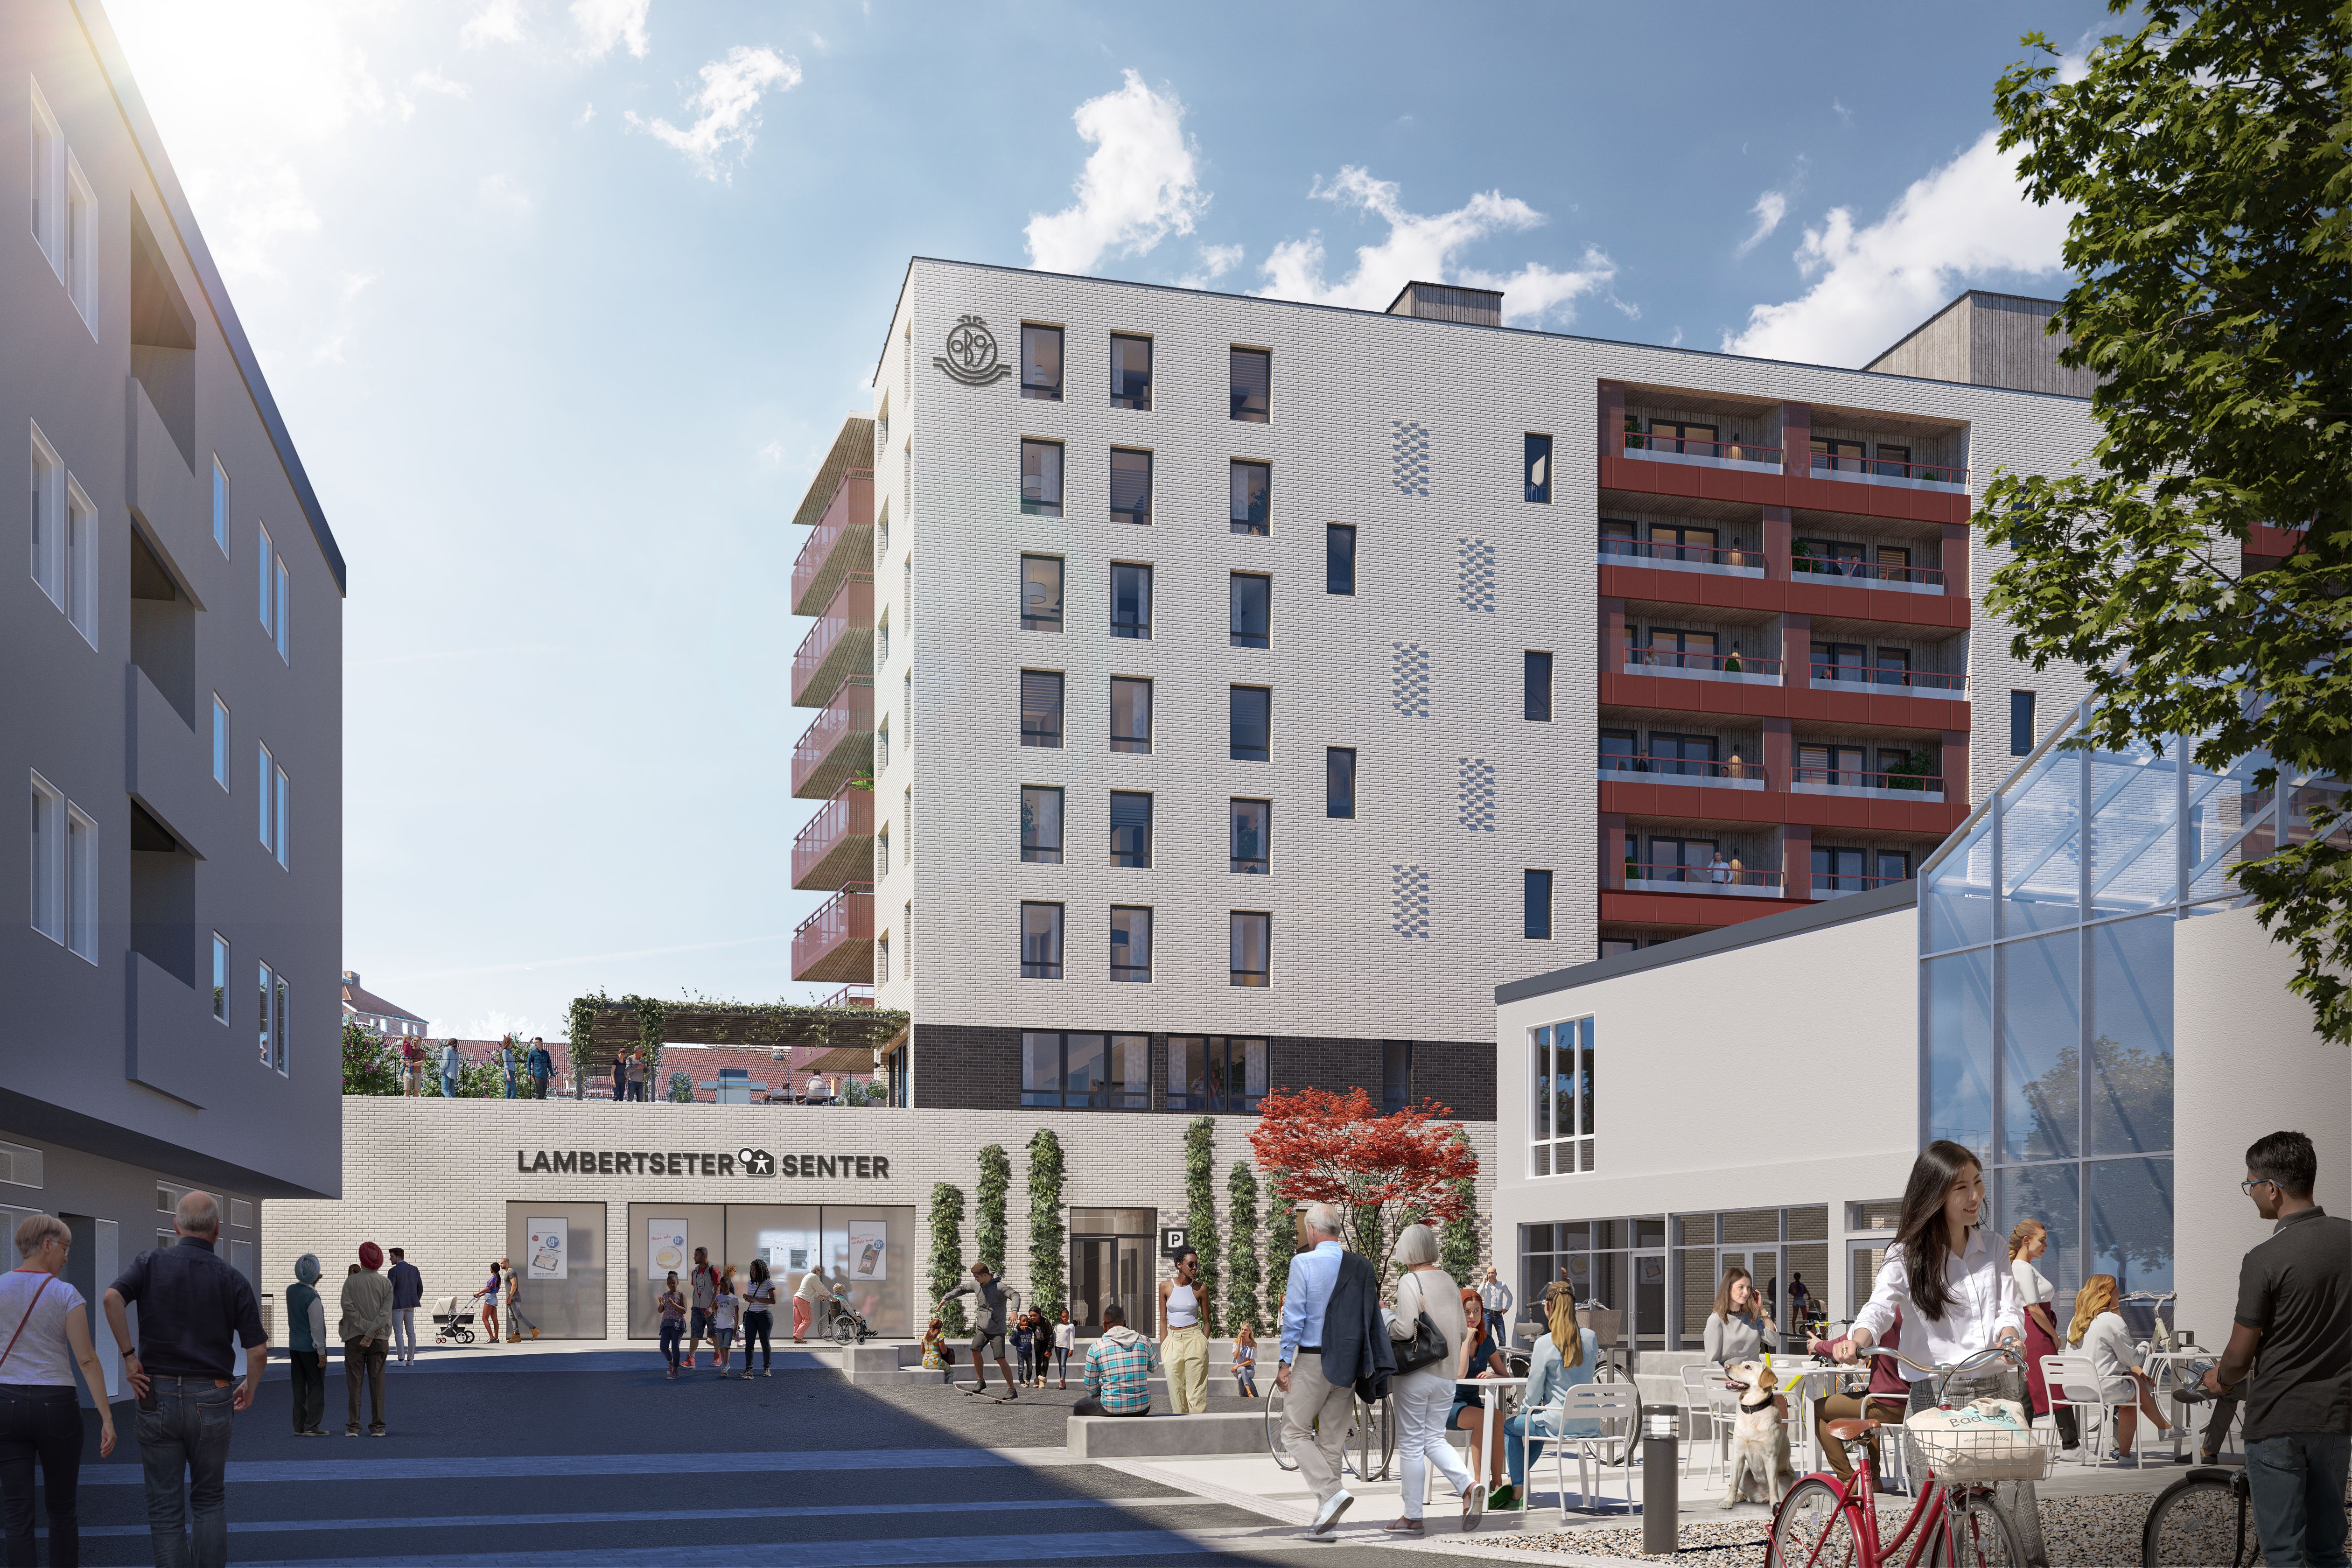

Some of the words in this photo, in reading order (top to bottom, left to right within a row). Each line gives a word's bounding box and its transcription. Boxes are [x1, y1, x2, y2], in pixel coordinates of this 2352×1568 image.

[518, 1150, 734, 1175] LAMBERTSETER
[782, 1155, 889, 1177] SENTER
[1172, 1234, 1180, 1245] P
[1949, 1414, 1982, 1428] Bad
